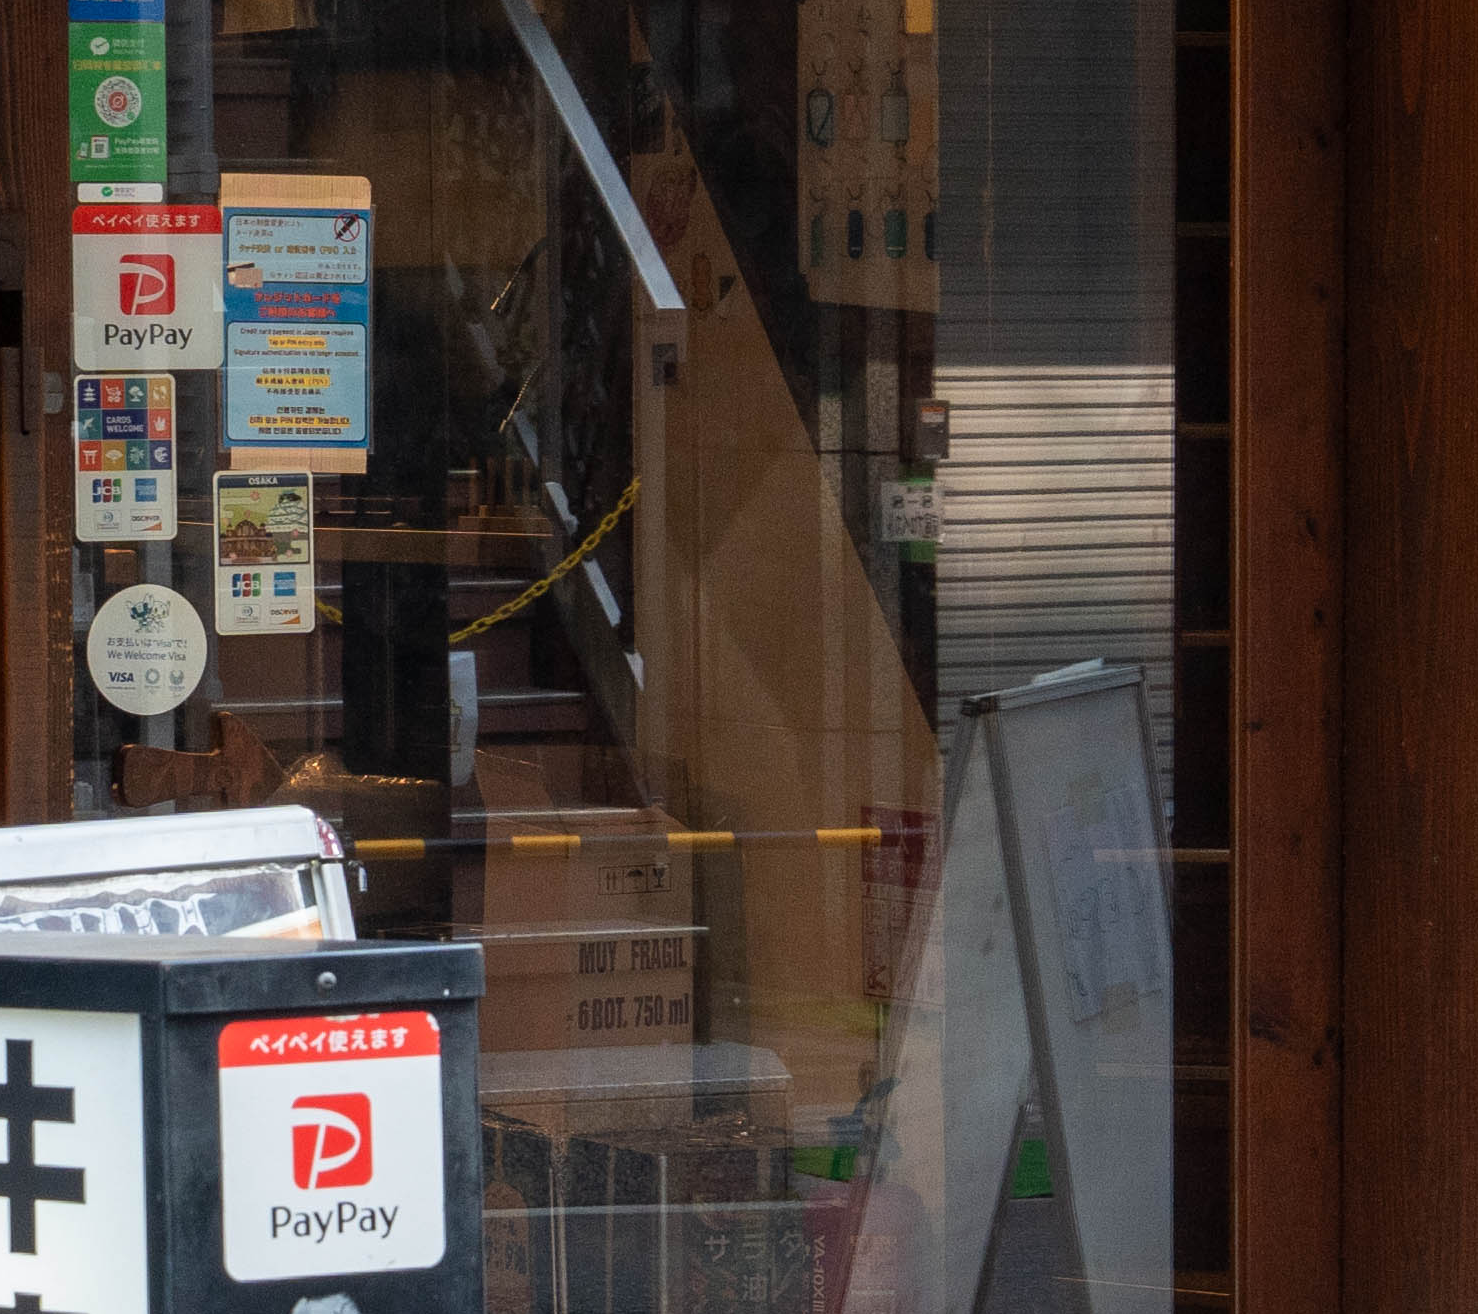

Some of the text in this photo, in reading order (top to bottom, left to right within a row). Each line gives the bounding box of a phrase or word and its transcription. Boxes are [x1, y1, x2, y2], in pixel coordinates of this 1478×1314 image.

[92, 214, 202, 228] ペイペイ使えます
[104, 323, 193, 350] PayPay
[106, 416, 131, 424] CARDS
[106, 425, 144, 433] WELCOME
[248, 477, 278, 485] OSAKA
[93, 483, 122, 499] JCB
[232, 578, 261, 593] JCB
[124, 651, 166, 661] Welcome
[168, 652, 186, 661] Visa
[108, 672, 135, 683] VISA
[578, 937, 687, 974] MUY FRAGIL
[633, 994, 663, 1027] 750
[250, 1025, 410, 1056] ペイペイ使えます
[269, 1200, 400, 1244] PayPay
